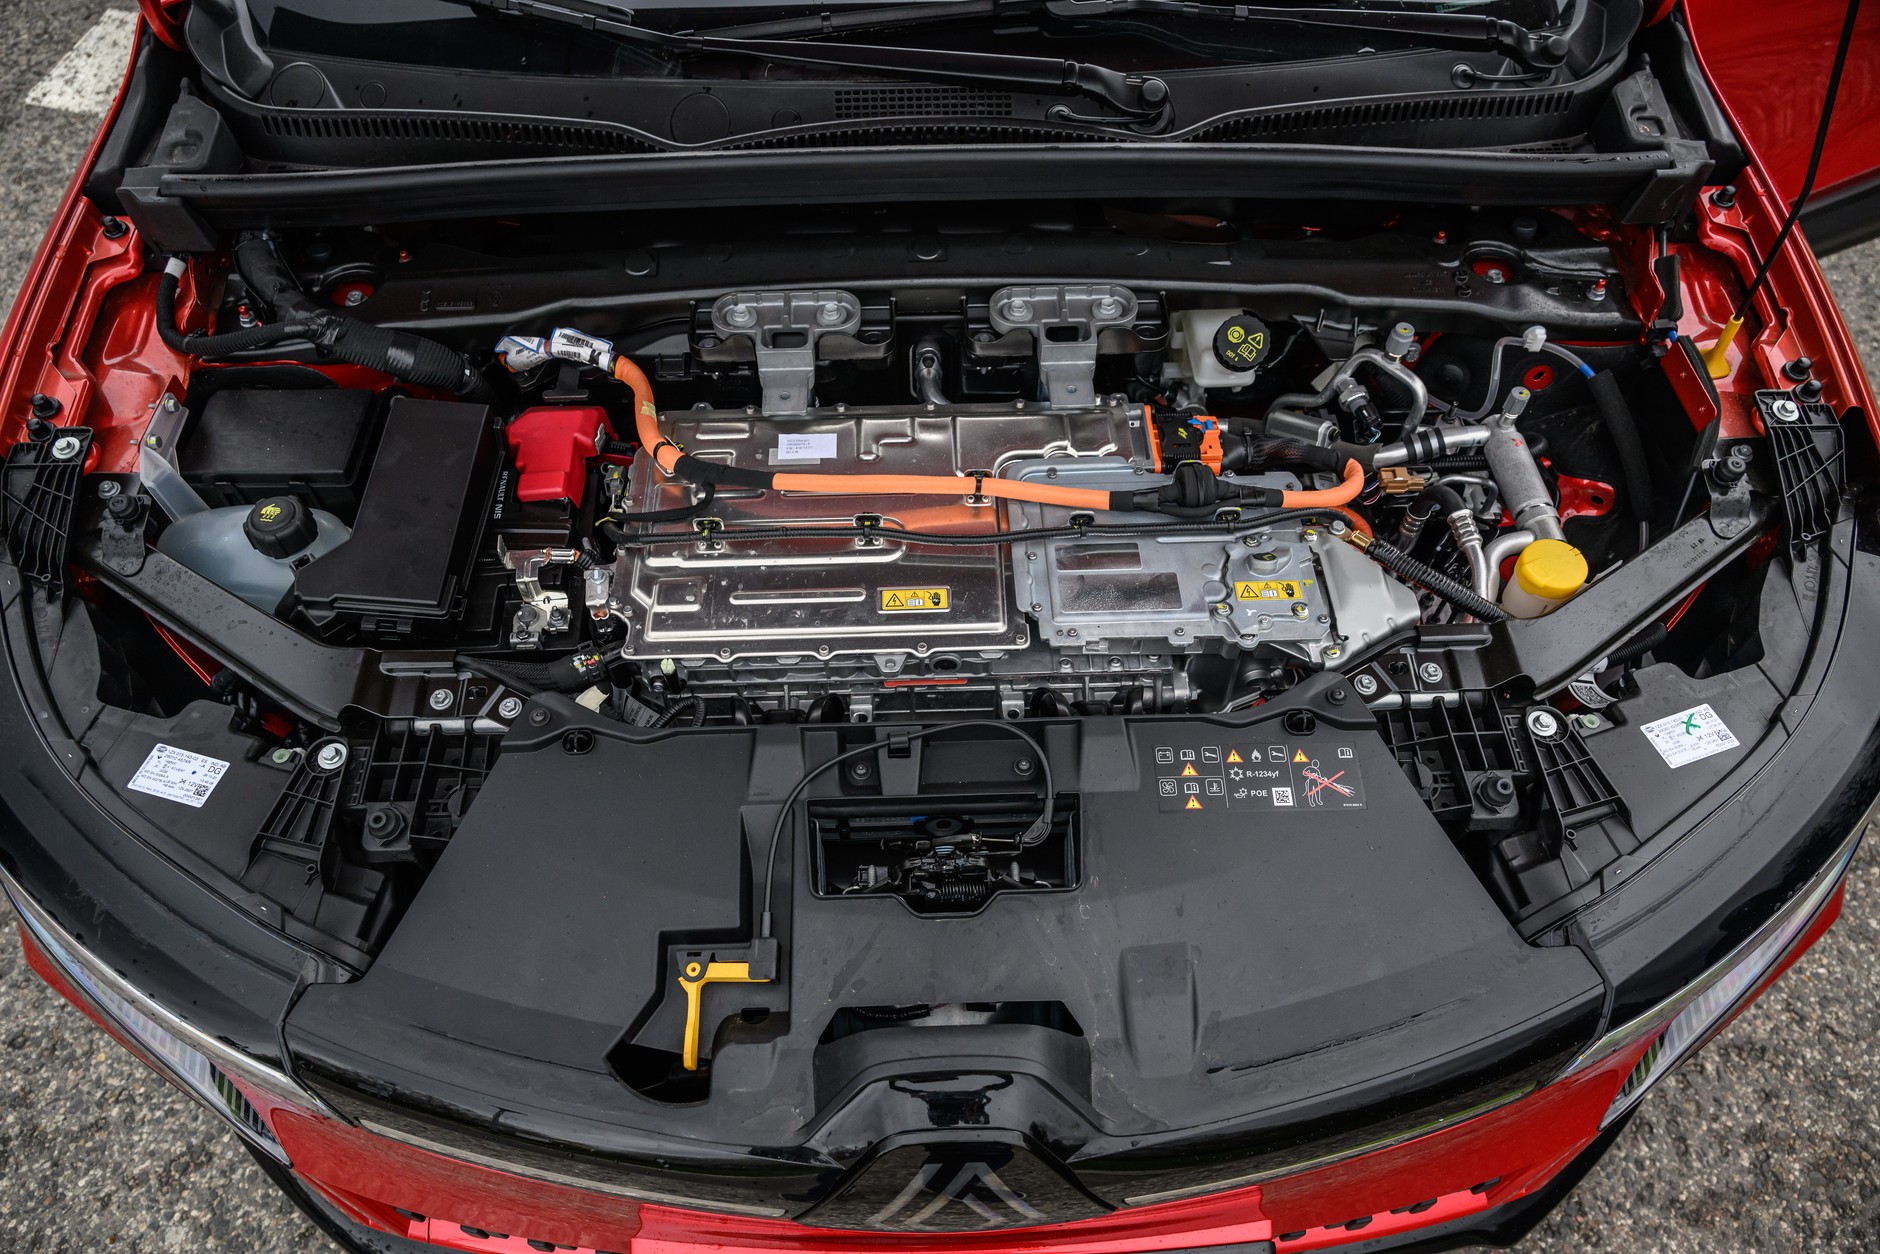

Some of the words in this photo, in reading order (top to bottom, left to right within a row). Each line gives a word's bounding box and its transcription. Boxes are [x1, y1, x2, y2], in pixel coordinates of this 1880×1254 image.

[1226, 350, 1235, 358] DOT
[497, 471, 508, 501] RENAULT
[1698, 711, 1713, 720] DG
[206, 765, 222, 774] DG
[1246, 770, 1279, 779] R-1234yf
